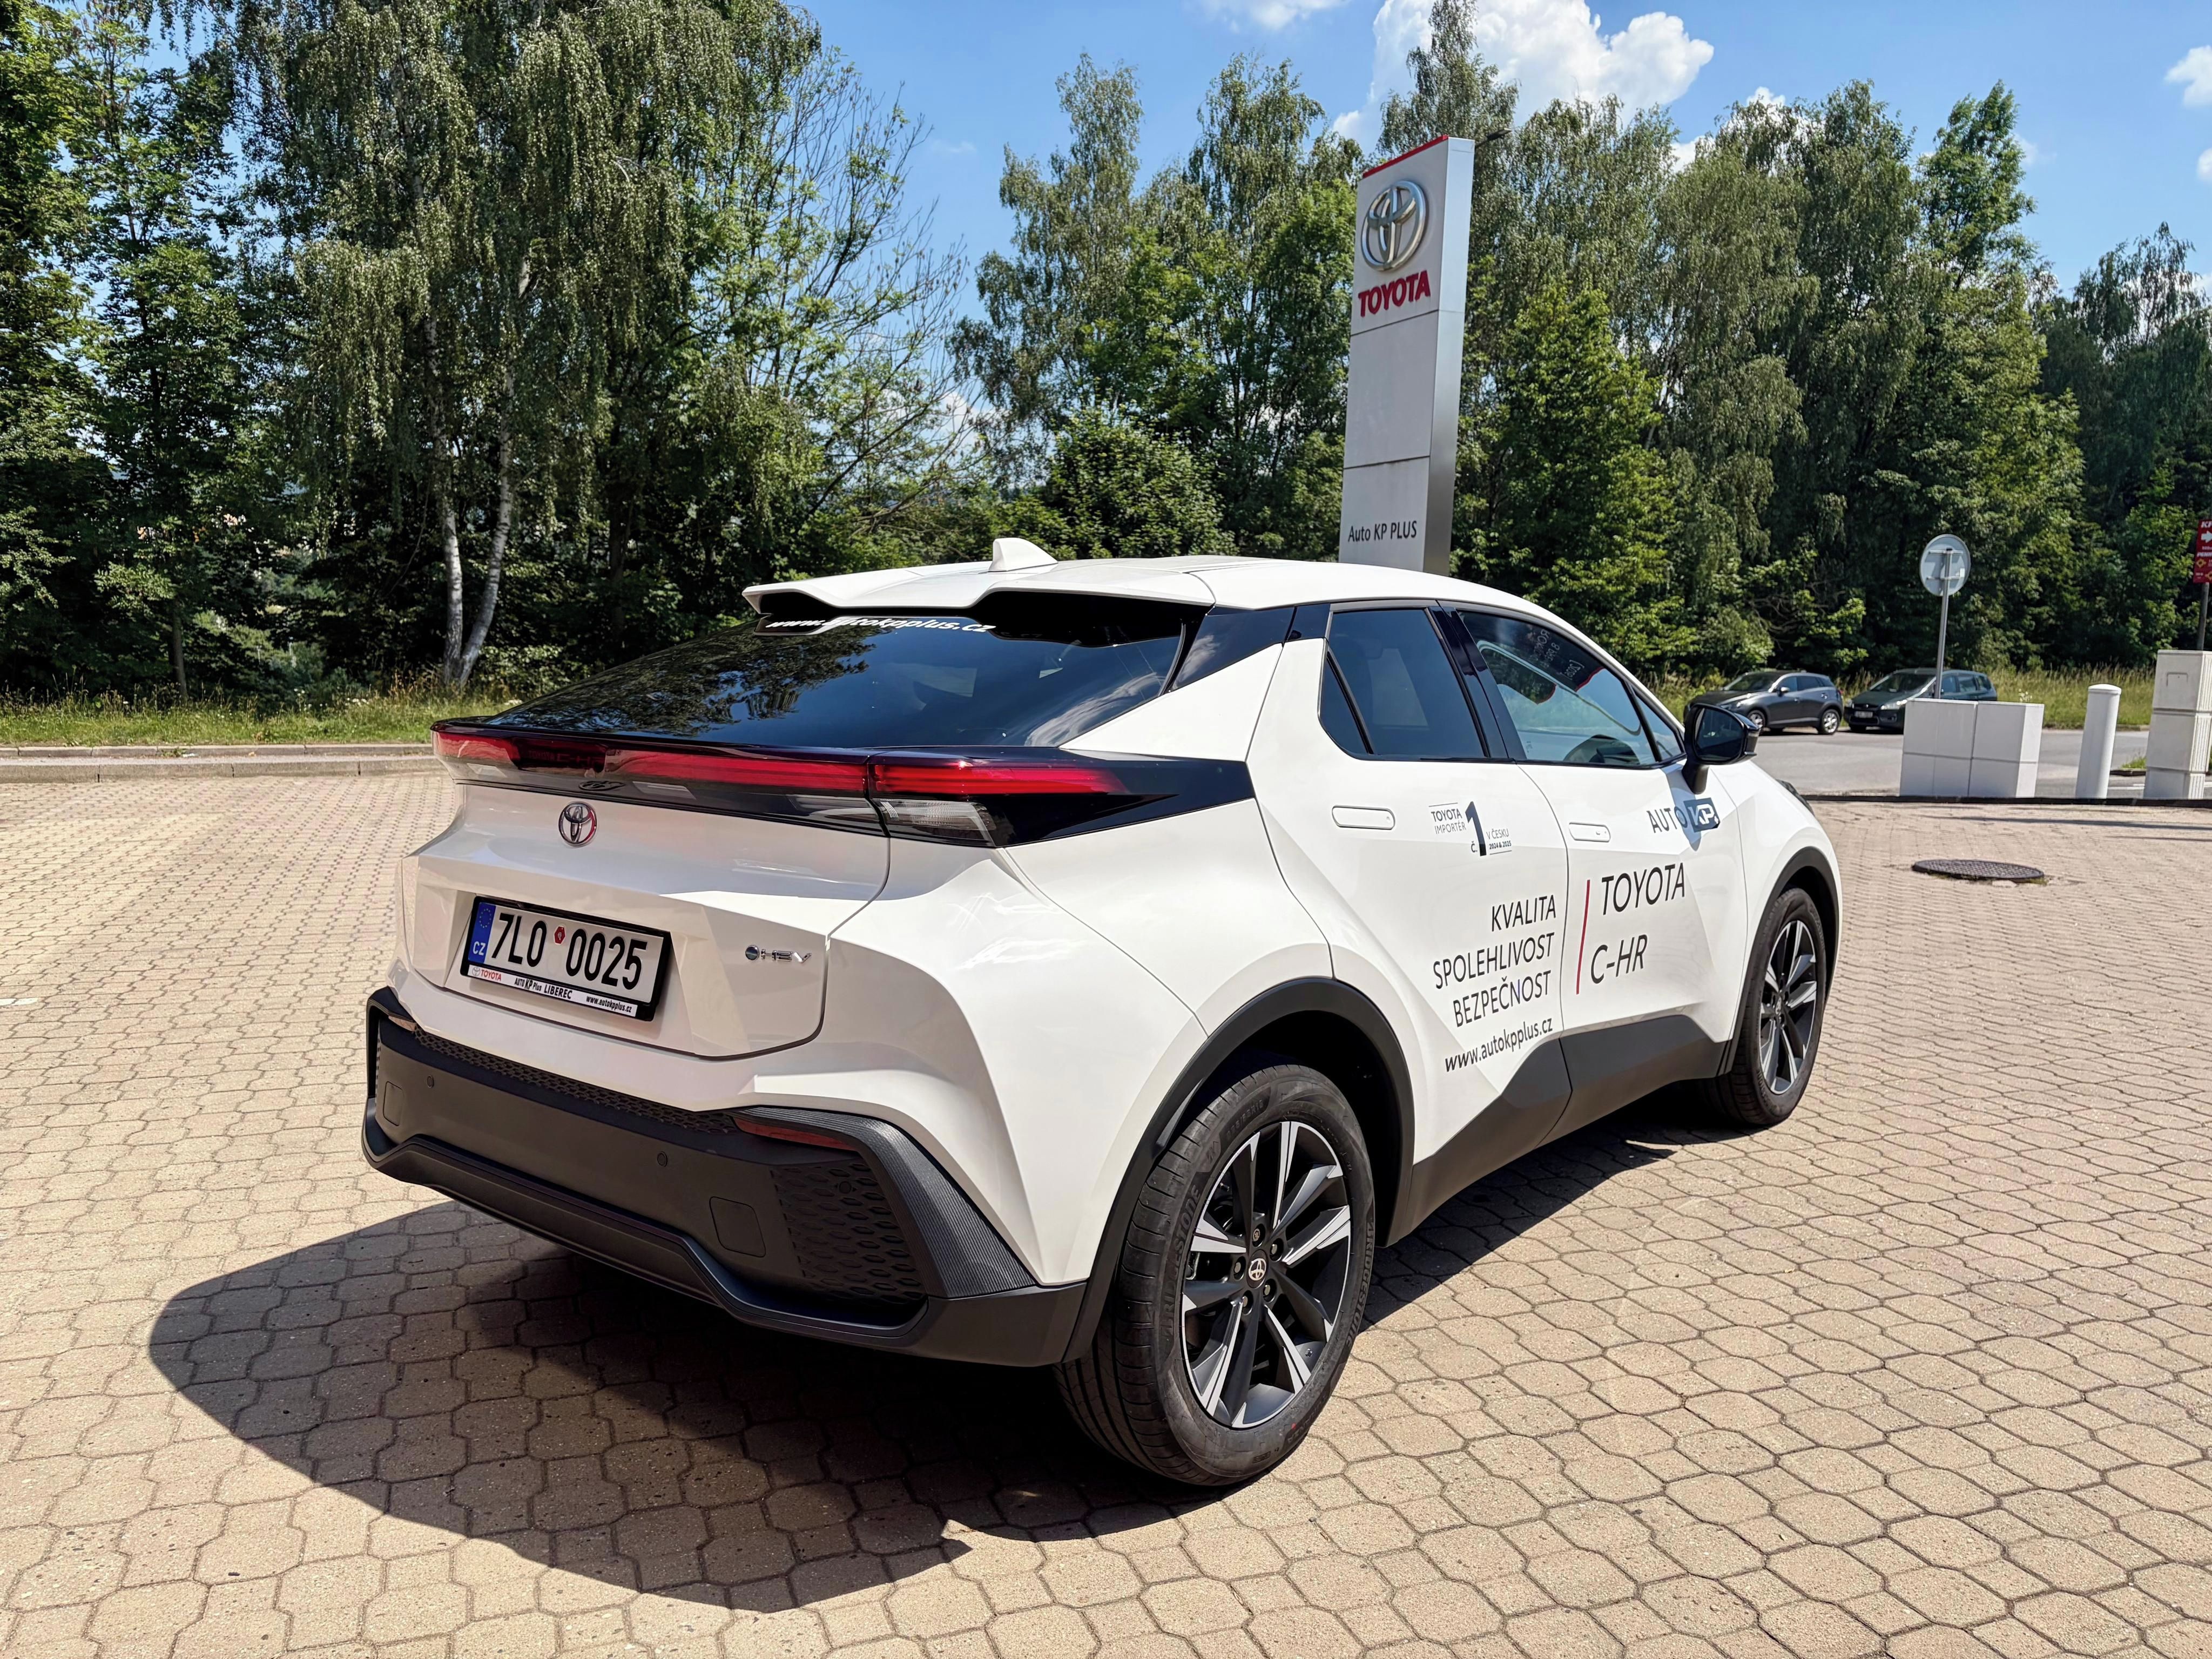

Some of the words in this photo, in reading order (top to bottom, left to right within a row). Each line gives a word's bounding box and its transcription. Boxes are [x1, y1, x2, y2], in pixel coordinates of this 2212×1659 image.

[1358, 269, 1431, 318] TOYOTA
[1347, 525, 1371, 542] Auto
[1374, 523, 1387, 541] KP
[1390, 520, 1417, 540] PLUS
[765, 617, 996, 633] www.autokpplus.cz
[1431, 808, 1463, 822] TOYOTA
[1434, 820, 1467, 834] IMPORTÉR
[1646, 806, 1688, 833] AUTO
[1465, 801, 1487, 857] 1
[1486, 831, 1491, 840] V
[1492, 828, 1509, 839] ČESKU
[1601, 862, 1685, 915] TOYOTA
[1491, 894, 1556, 932] KVALITA
[473, 941, 485, 956] CZ
[565, 928, 648, 990] 0025
[1432, 932, 1555, 989] SPOLEHLIVOST
[1590, 934, 1648, 984] C-HR
[480, 968, 502, 982] TOYOTA
[514, 977, 525, 988] AUTO
[524, 979, 533, 990] KP
[532, 982, 542, 992] Plus
[544, 983, 573, 1000] LIBEREC
[586, 995, 632, 1013] www.autokpplus.cz
[1453, 970, 1552, 1027] BEZPEČNOST
[1445, 1017, 1553, 1072] www.autokpplus.cz
